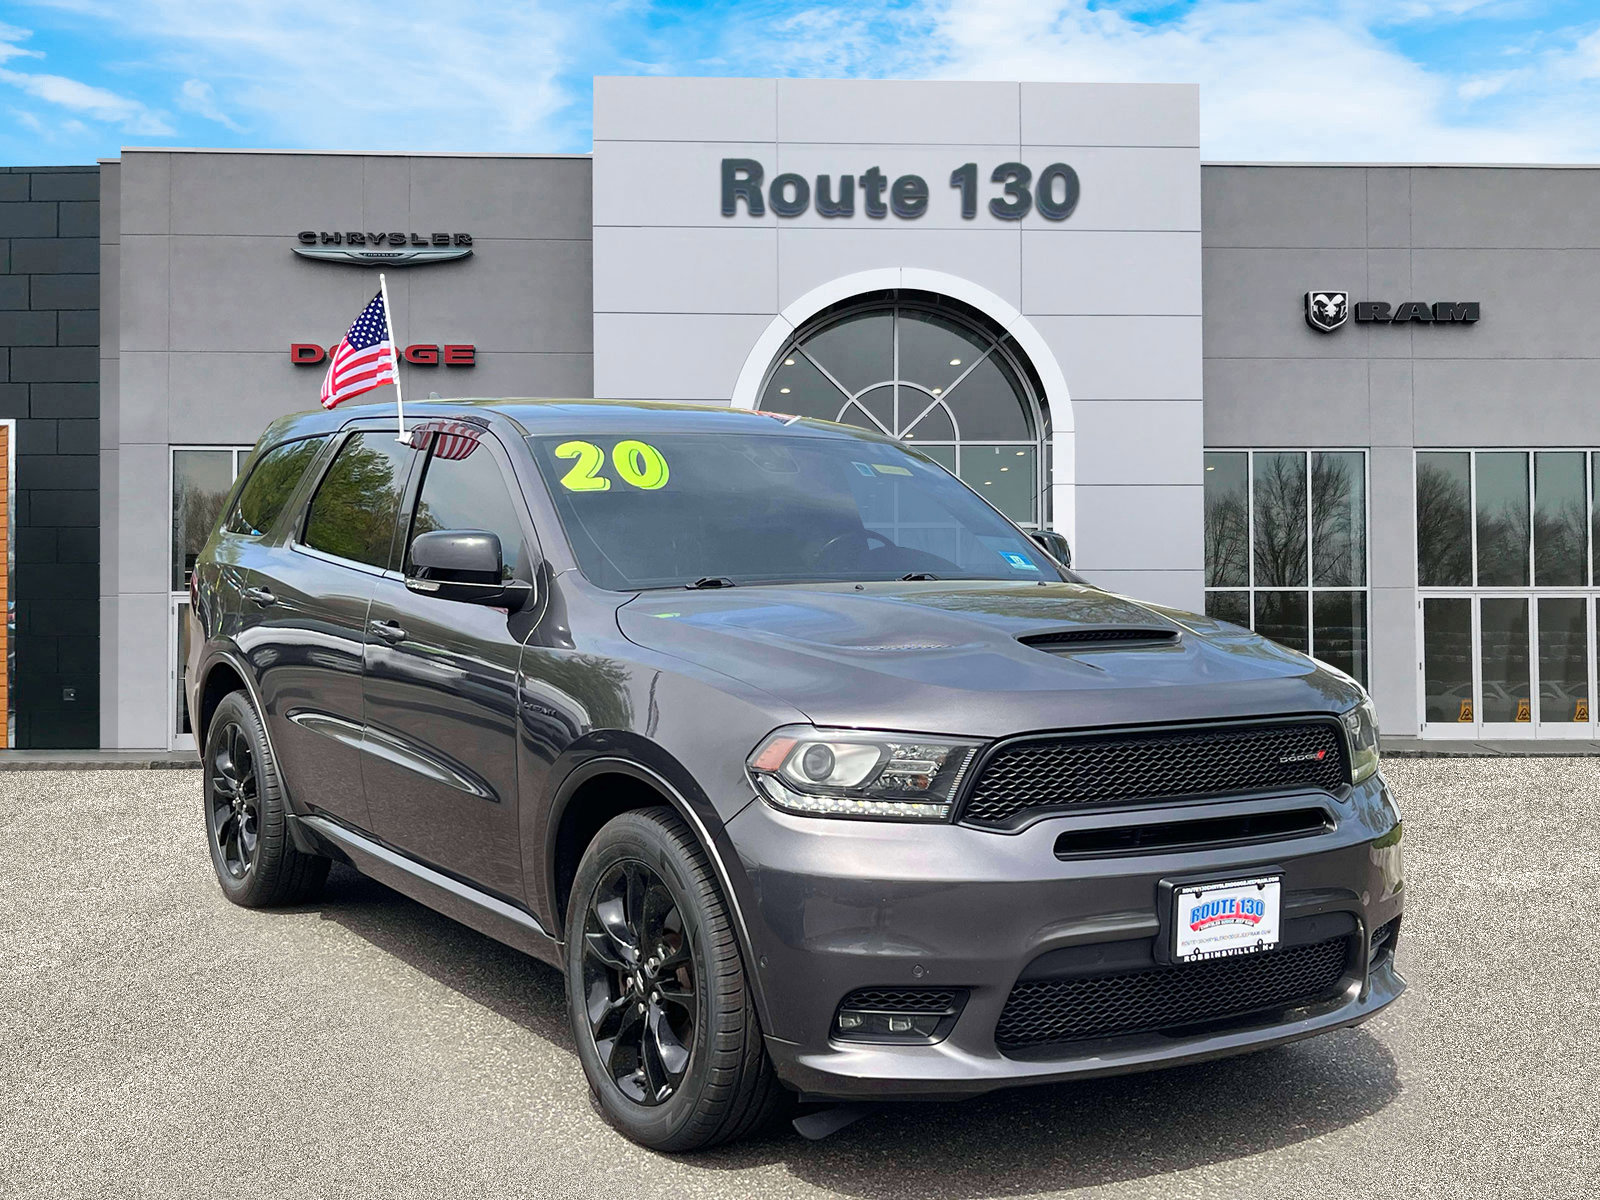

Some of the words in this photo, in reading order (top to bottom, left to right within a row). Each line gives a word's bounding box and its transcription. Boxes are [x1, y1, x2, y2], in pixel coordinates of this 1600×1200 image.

[721, 158, 929, 218] Route
[950, 162, 1080, 220] 130
[298, 231, 473, 246] CHRYSLER
[1355, 302, 1480, 323] RAM
[291, 343, 476, 366] DGE
[554, 440, 670, 492] 20
[1190, 898, 1236, 924] ROUTE
[1240, 897, 1265, 917] 130
